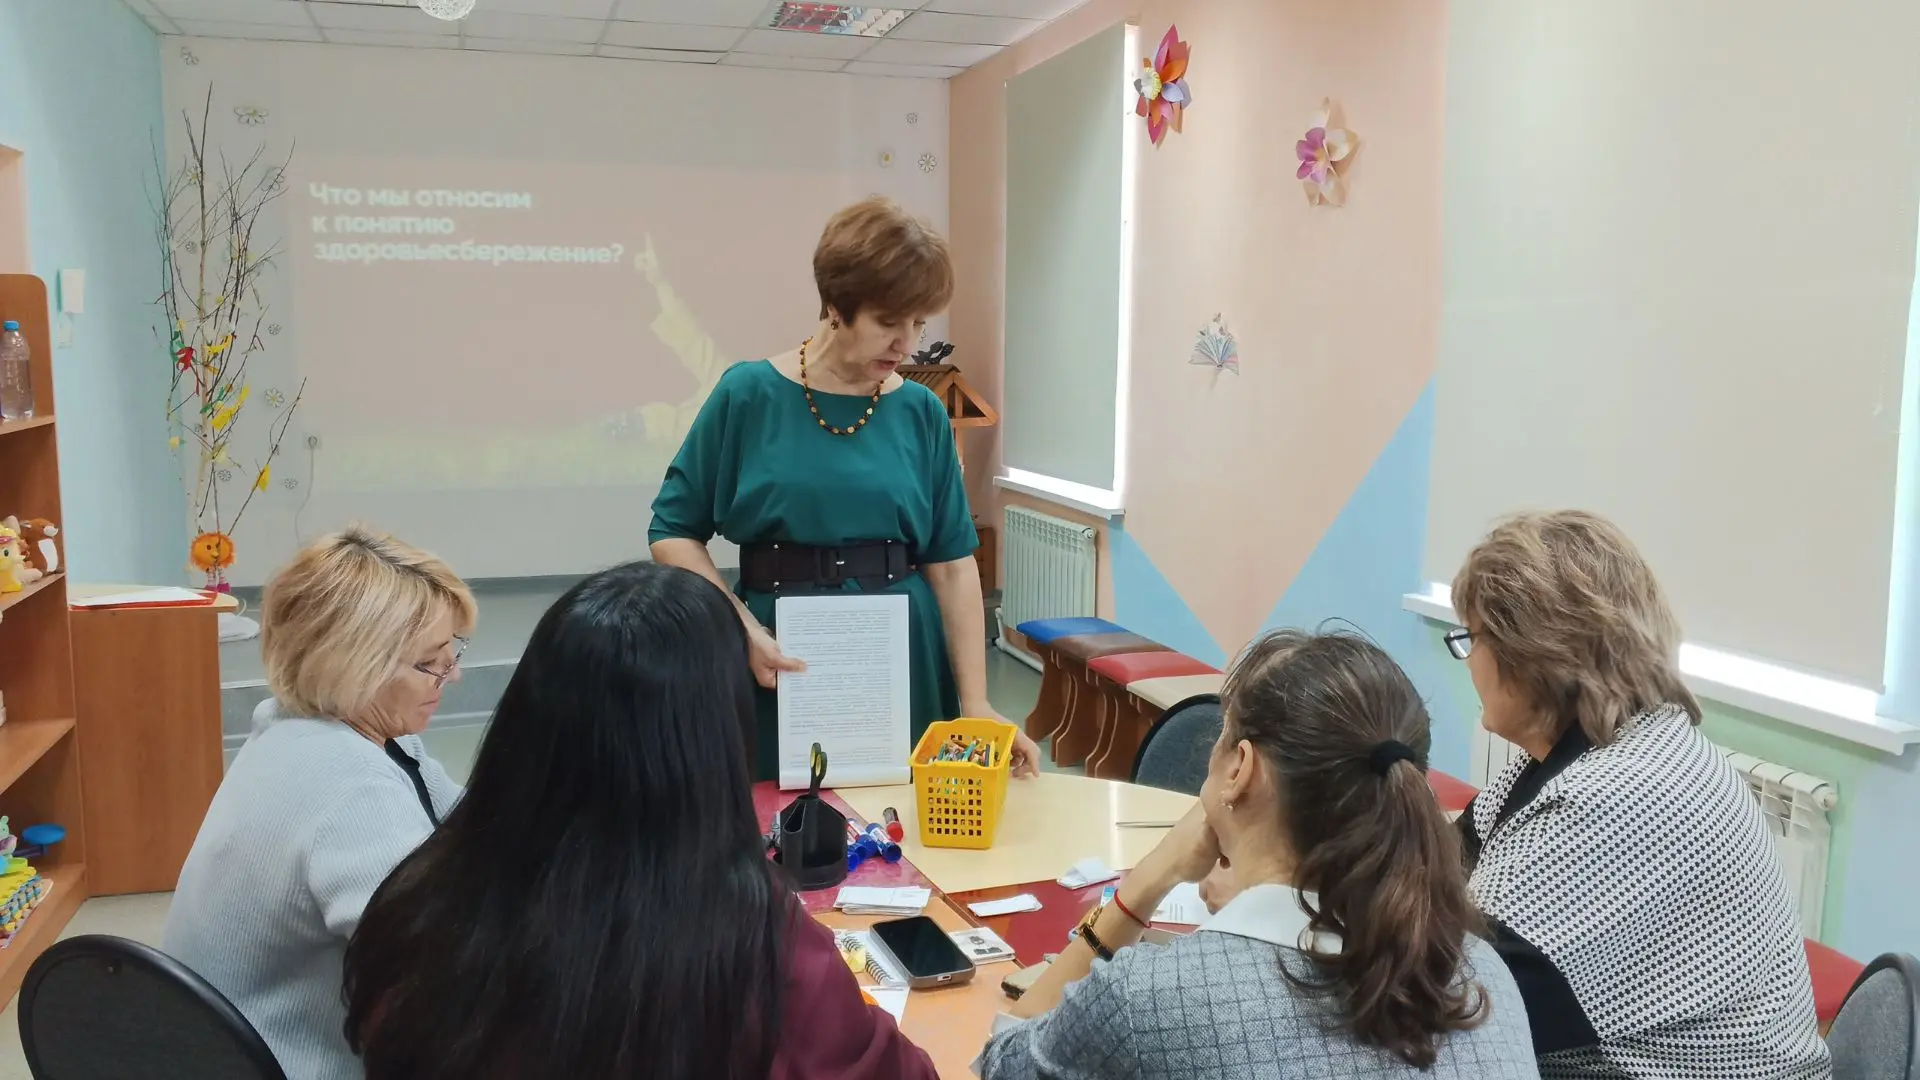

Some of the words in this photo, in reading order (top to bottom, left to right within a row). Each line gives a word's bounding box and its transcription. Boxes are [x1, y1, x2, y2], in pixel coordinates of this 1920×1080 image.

[309, 182, 361, 206] Что
[367, 188, 410, 206] мы
[414, 189, 533, 209] относим
[312, 215, 328, 233] к
[334, 215, 455, 234] понятию
[314, 238, 625, 267] здоровьесбережение?
